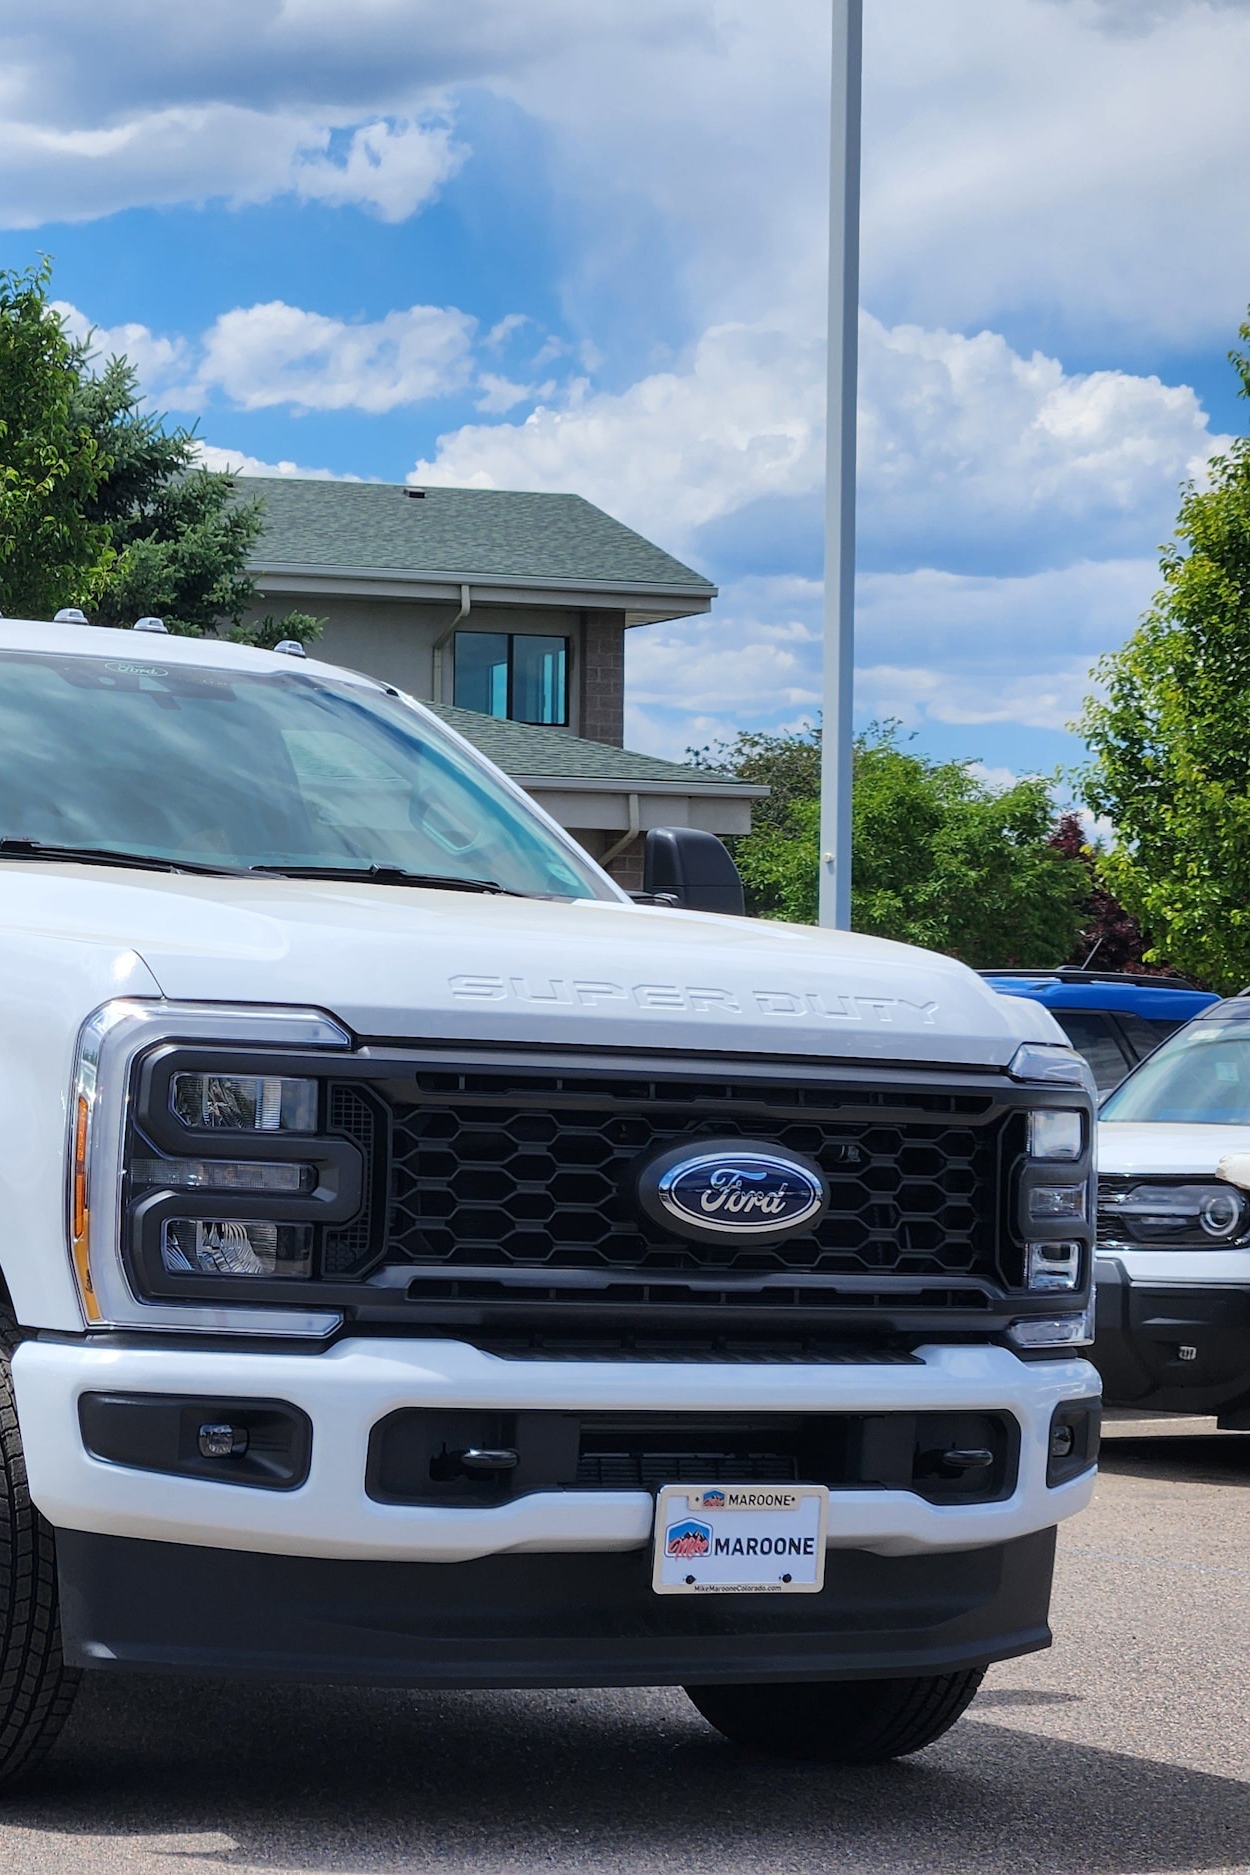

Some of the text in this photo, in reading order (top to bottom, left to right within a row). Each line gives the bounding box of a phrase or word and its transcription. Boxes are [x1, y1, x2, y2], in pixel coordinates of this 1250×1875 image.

[117, 663, 159, 676] Ford
[447, 973, 941, 1025] SUPER DUTY
[701, 1168, 789, 1215] Ford
[728, 1493, 792, 1506] MAROONE
[668, 1536, 815, 1561] Mike MAROONE
[693, 1584, 783, 1593] MikeMarooneColorado.com
